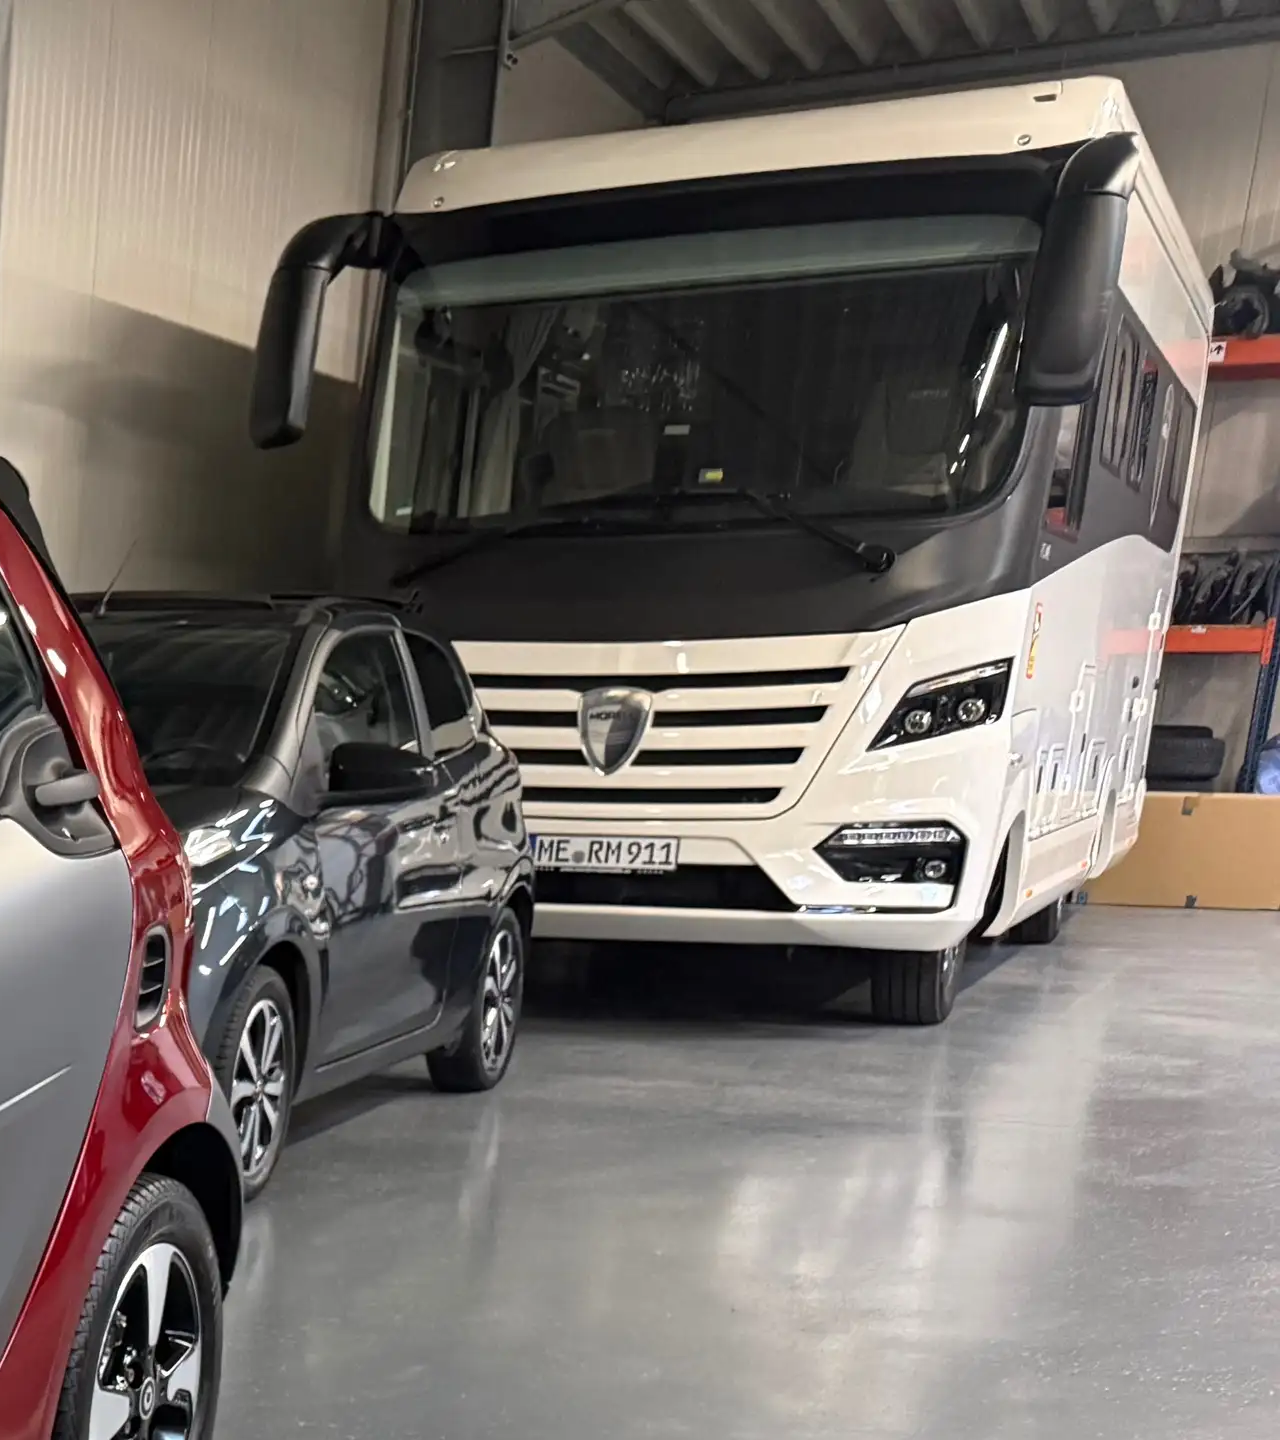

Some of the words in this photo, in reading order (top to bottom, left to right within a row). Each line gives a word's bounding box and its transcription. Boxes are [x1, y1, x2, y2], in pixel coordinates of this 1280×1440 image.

[536, 839, 571, 863] ME
[587, 840, 623, 864] RM
[627, 841, 673, 866] 911
